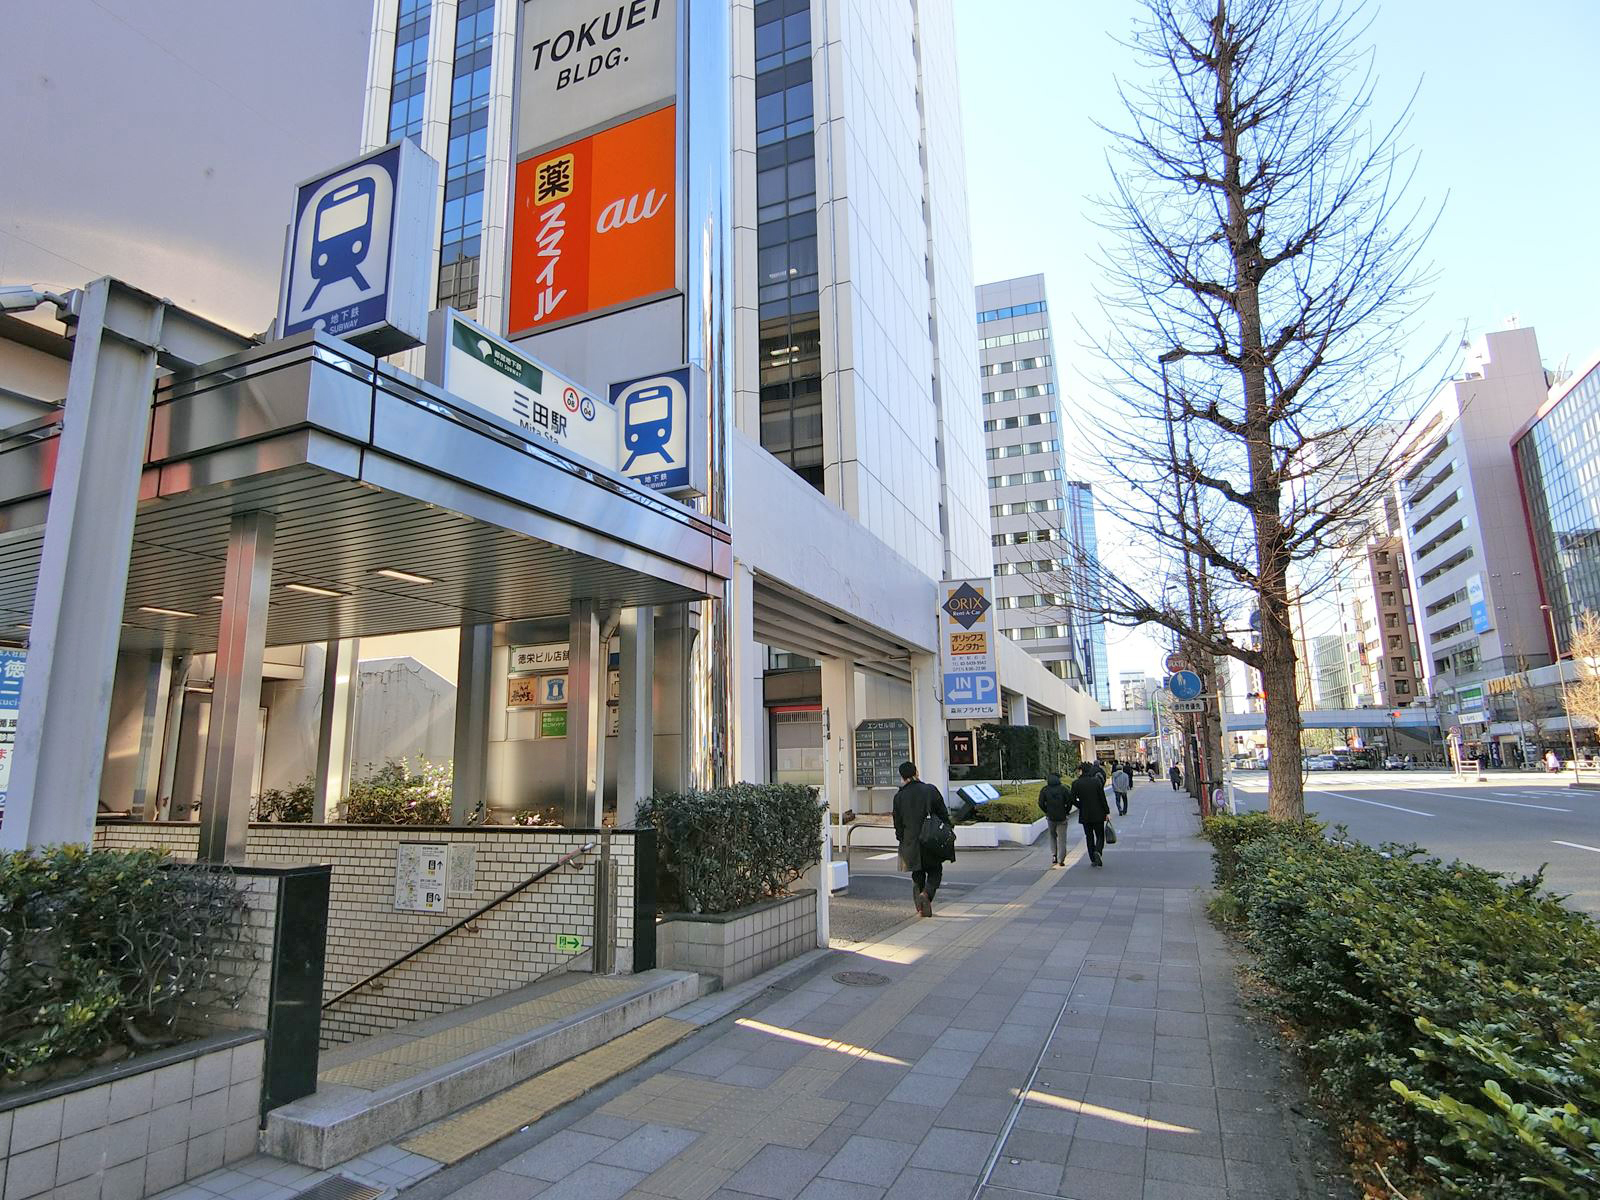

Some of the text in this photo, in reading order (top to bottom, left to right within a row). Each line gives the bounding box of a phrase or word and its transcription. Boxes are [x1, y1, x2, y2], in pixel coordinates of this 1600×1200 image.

[532, 0, 661, 71] TOKUEI
[556, 47, 629, 91] BLDG.
[596, 188, 667, 234] au
[330, 307, 360, 324] 地下鉄
[329, 318, 359, 334] SUBWAY
[513, 390, 568, 438] 三田駅
[644, 473, 667, 483] 地下鉄
[948, 597, 982, 610] ORIX
[952, 633, 984, 642] オリックス
[952, 643, 985, 652] レンタカー
[955, 675, 995, 701] IN P
[954, 743, 968, 751] IN
